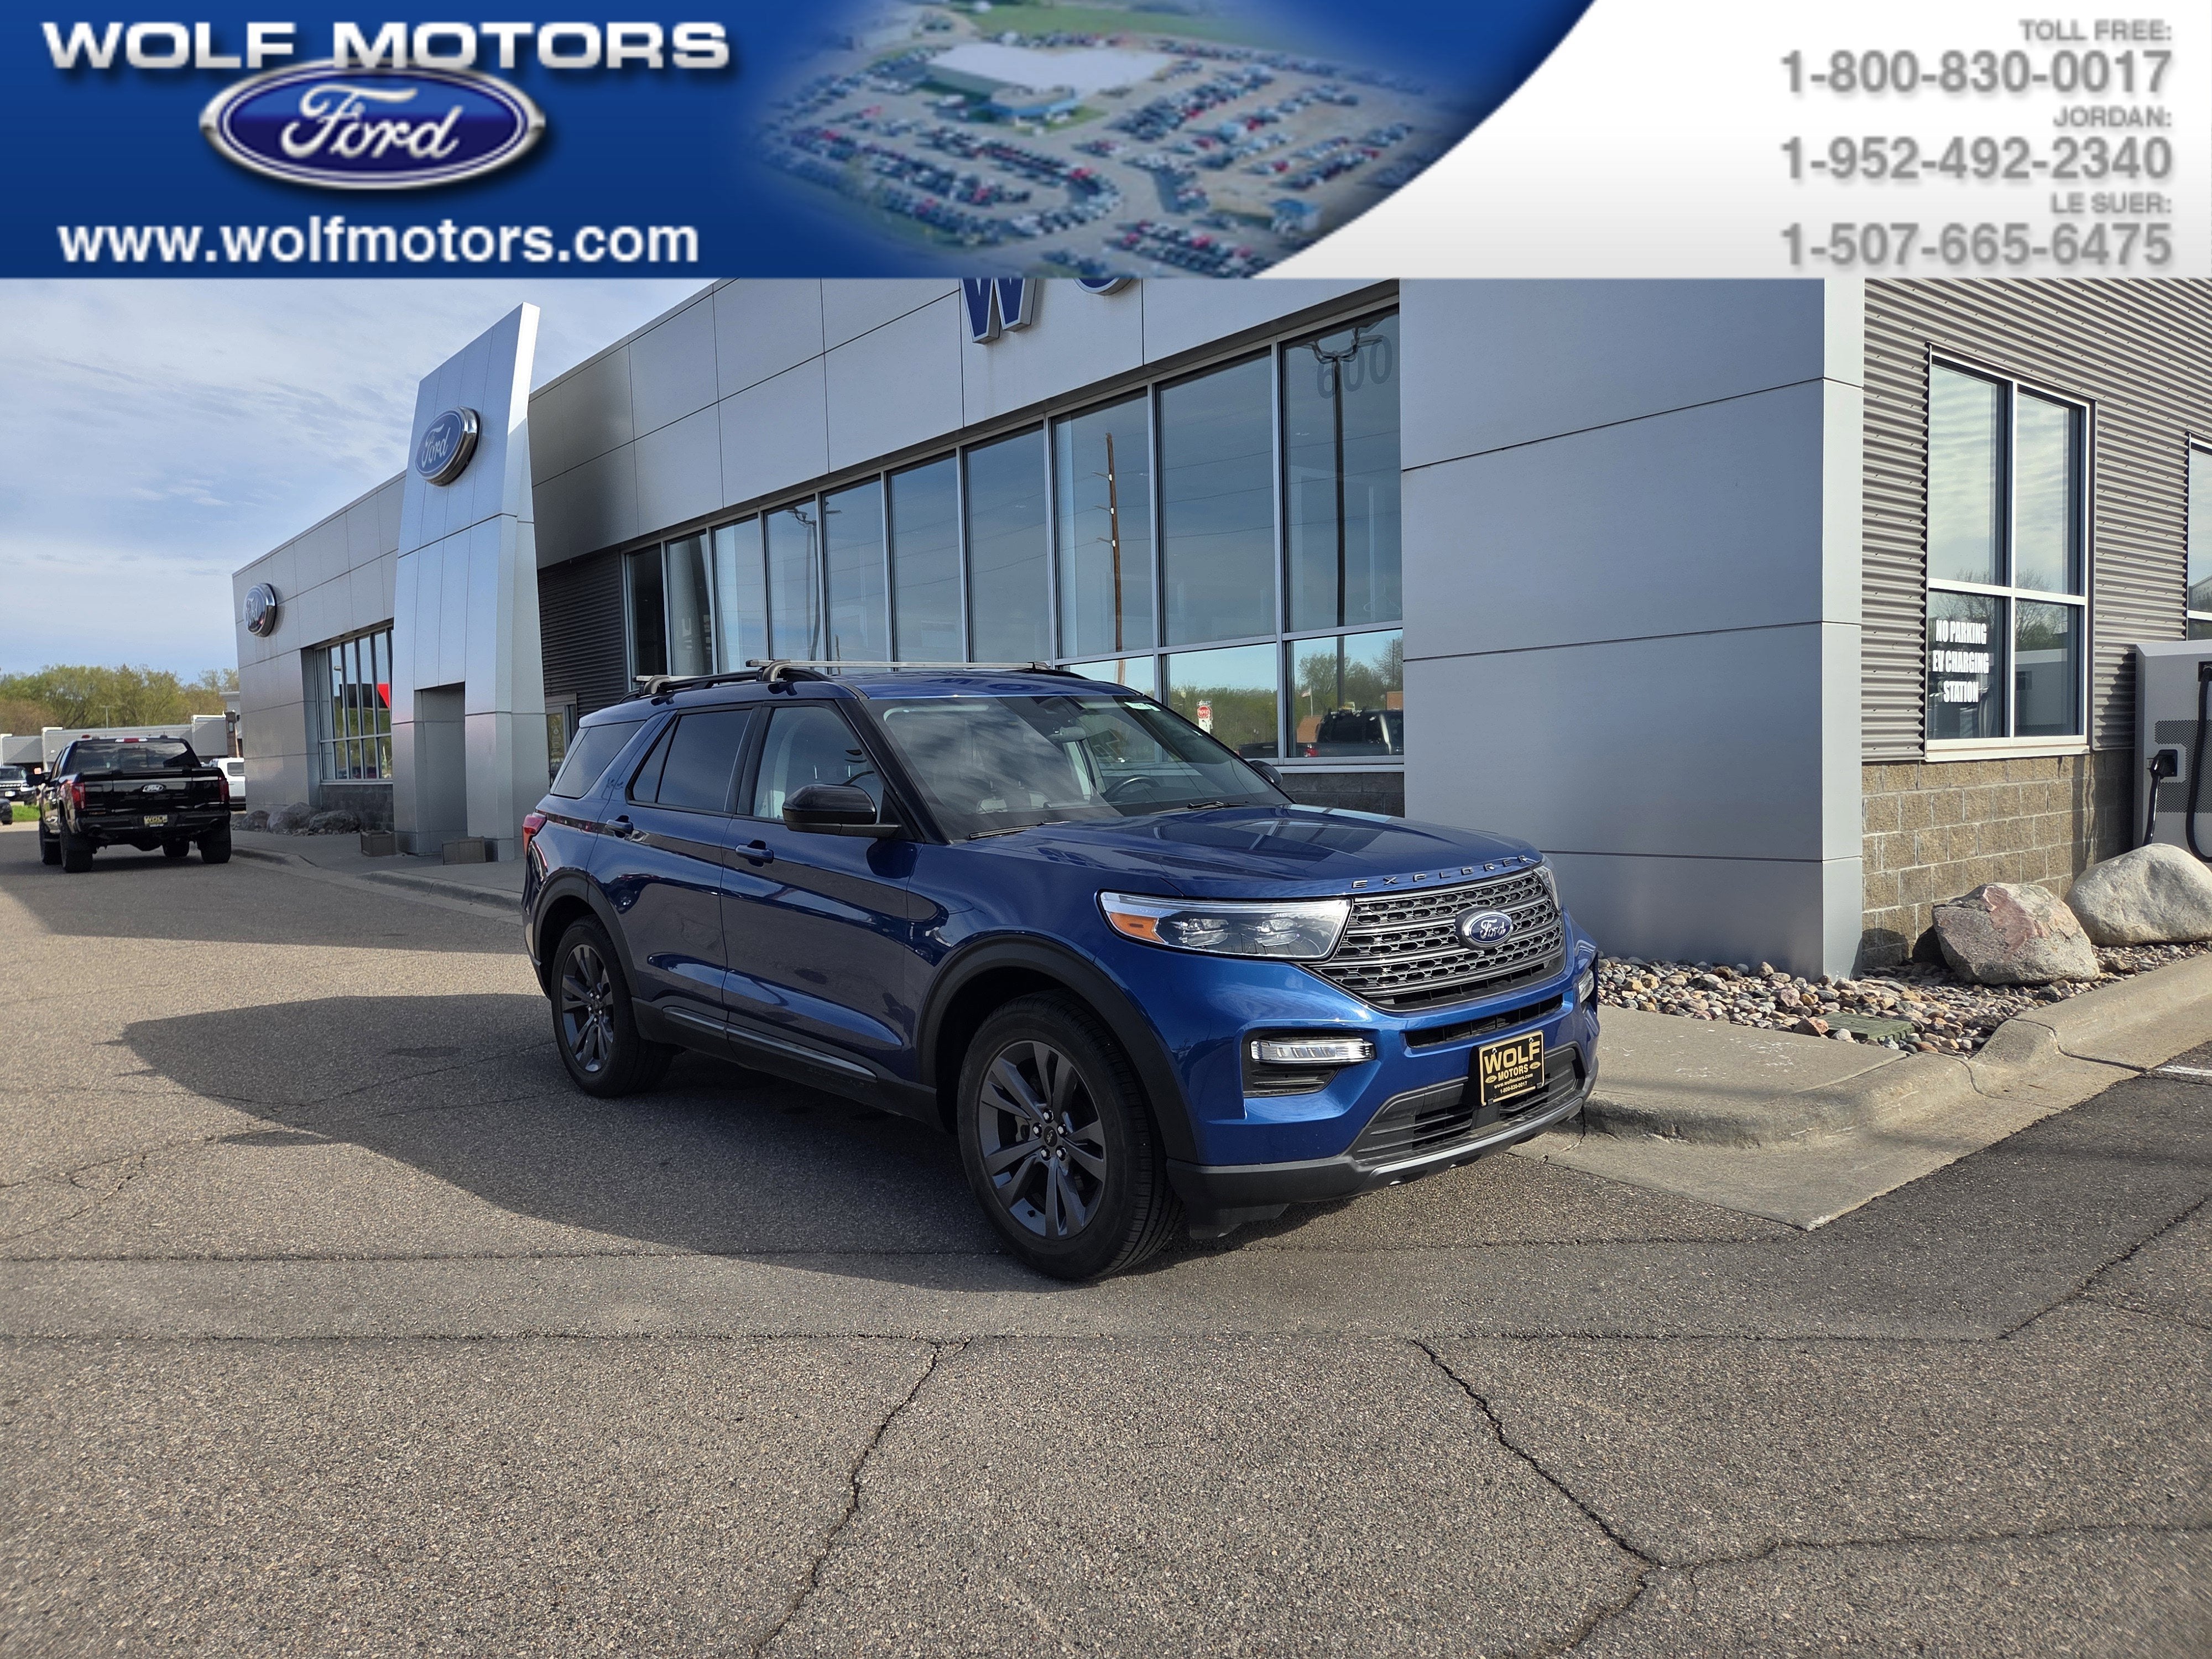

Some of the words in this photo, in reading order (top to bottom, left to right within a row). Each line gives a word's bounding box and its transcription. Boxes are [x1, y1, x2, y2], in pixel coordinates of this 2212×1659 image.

[422, 424, 450, 468] Ford
[1936, 619, 1949, 643] NO
[1950, 621, 1987, 645] PARKING
[1932, 650, 1944, 672] EV
[1945, 650, 1989, 674] CHARGING
[1943, 680, 1979, 703] STATION
[1352, 854, 1527, 888] EXPLORER
[1480, 919, 1506, 939] Ford
[1484, 1040, 1540, 1074] WOLF
[1498, 1063, 1528, 1082] MOTORS
